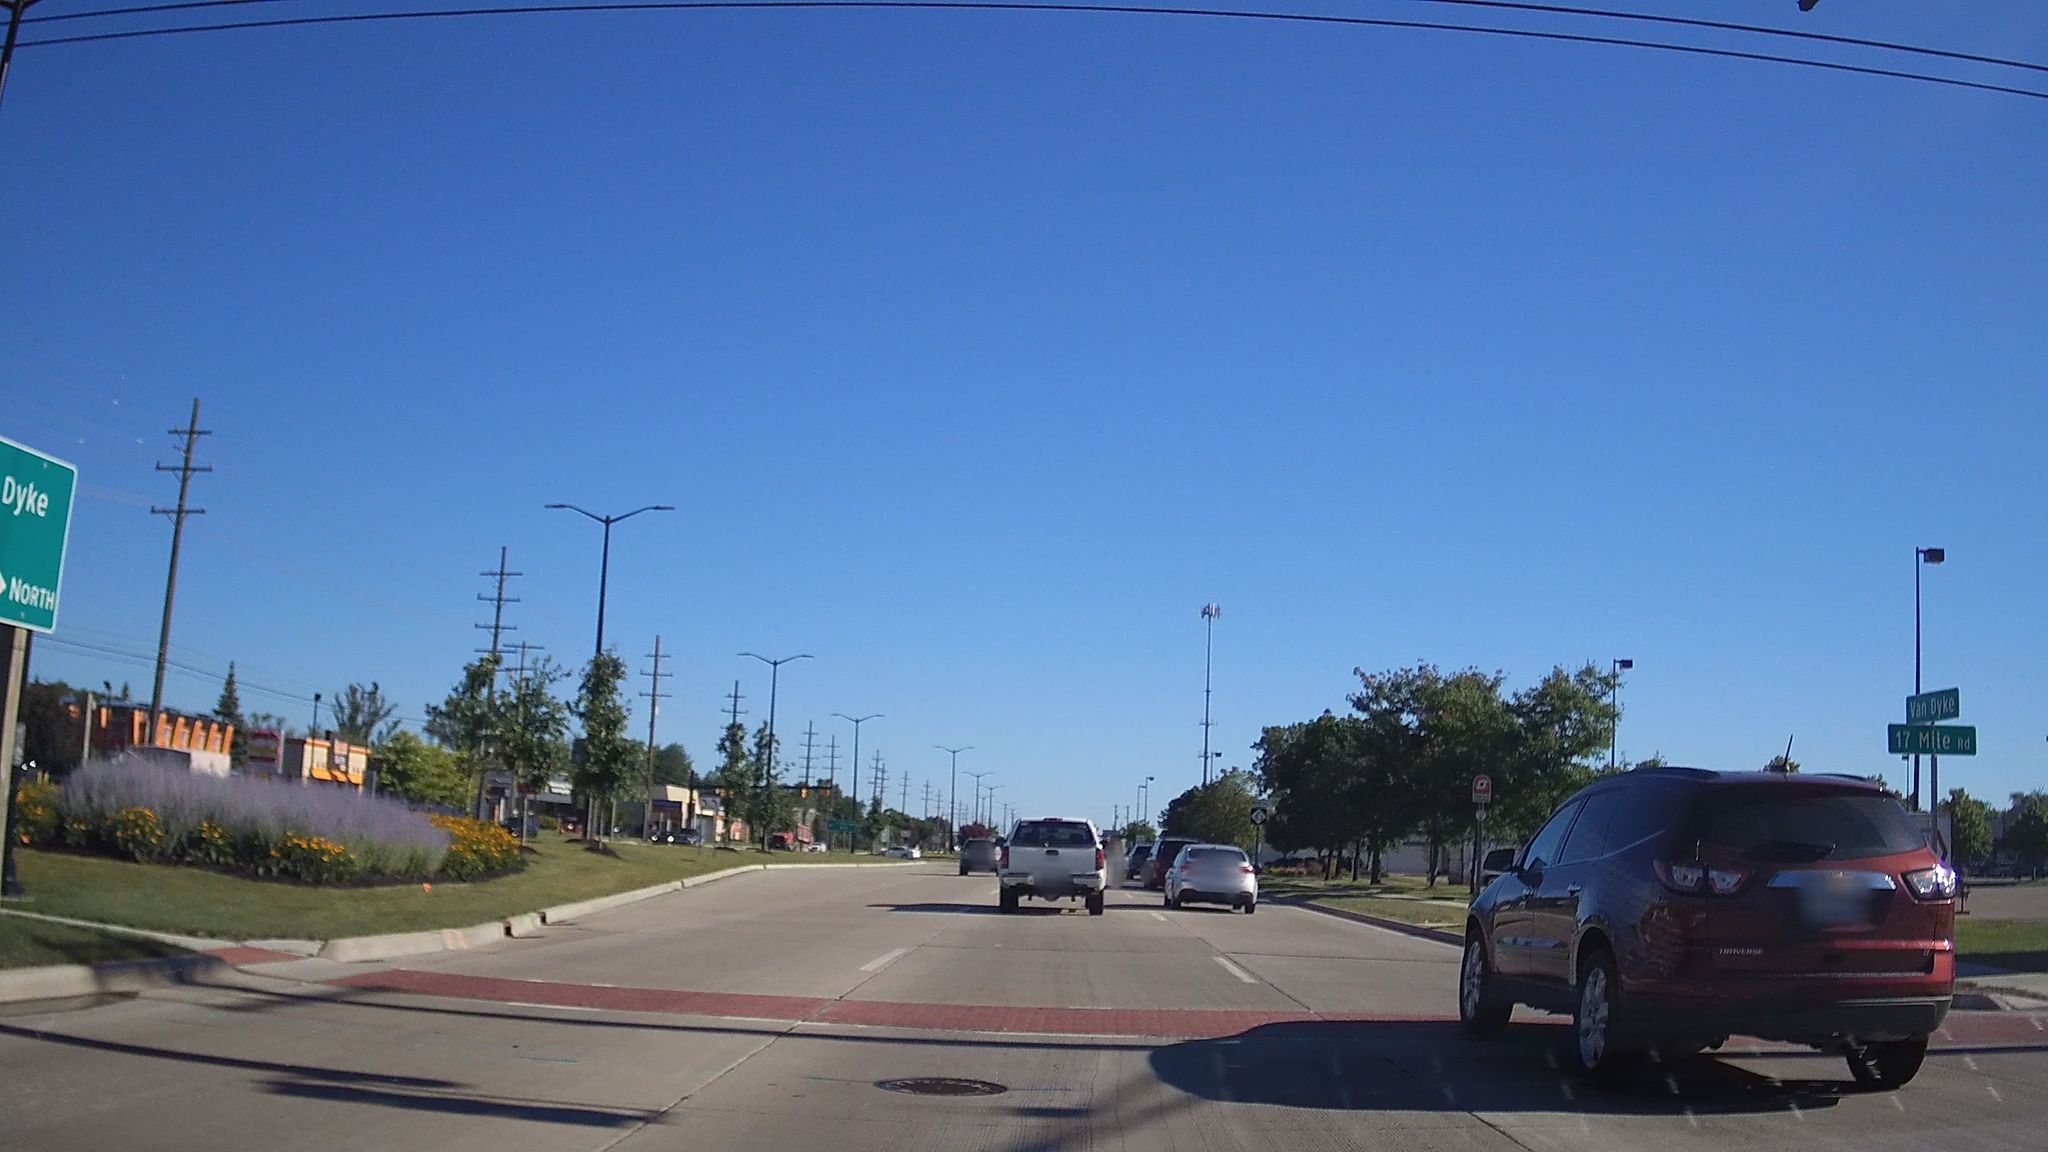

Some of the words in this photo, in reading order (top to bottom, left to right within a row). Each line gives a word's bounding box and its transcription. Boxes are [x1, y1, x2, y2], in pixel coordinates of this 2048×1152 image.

[2, 475, 49, 517] Dyke
[8, 576, 55, 611] NORTH
[1910, 701, 1927, 718] Van
[1930, 696, 1955, 719] Dyke
[1895, 730, 1911, 749] 17
[1919, 730, 1951, 750] Mile
[1957, 736, 1970, 751] Rd
